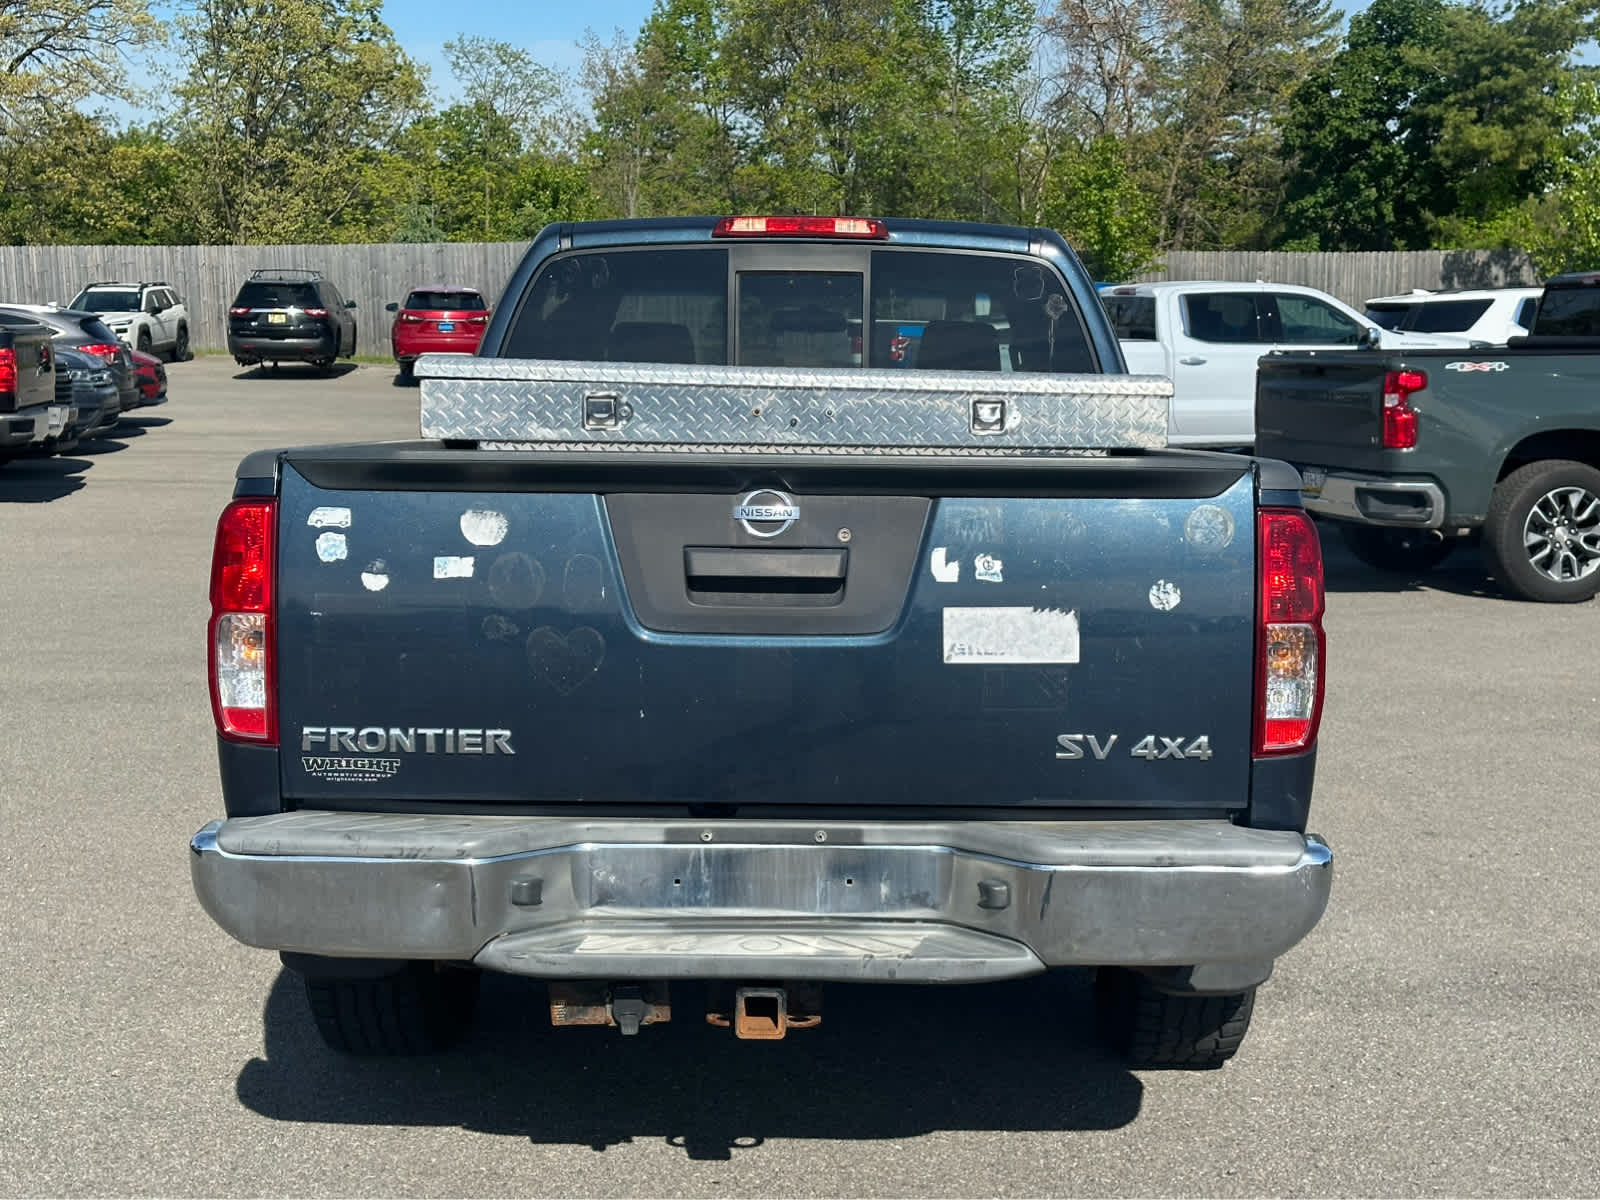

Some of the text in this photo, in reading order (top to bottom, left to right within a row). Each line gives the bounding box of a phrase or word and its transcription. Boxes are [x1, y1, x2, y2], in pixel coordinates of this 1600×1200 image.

[740, 507, 793, 517] NISSAN
[302, 726, 516, 755] FRONTIER
[1055, 733, 1119, 760] SV
[302, 756, 400, 773] WRIGHT
